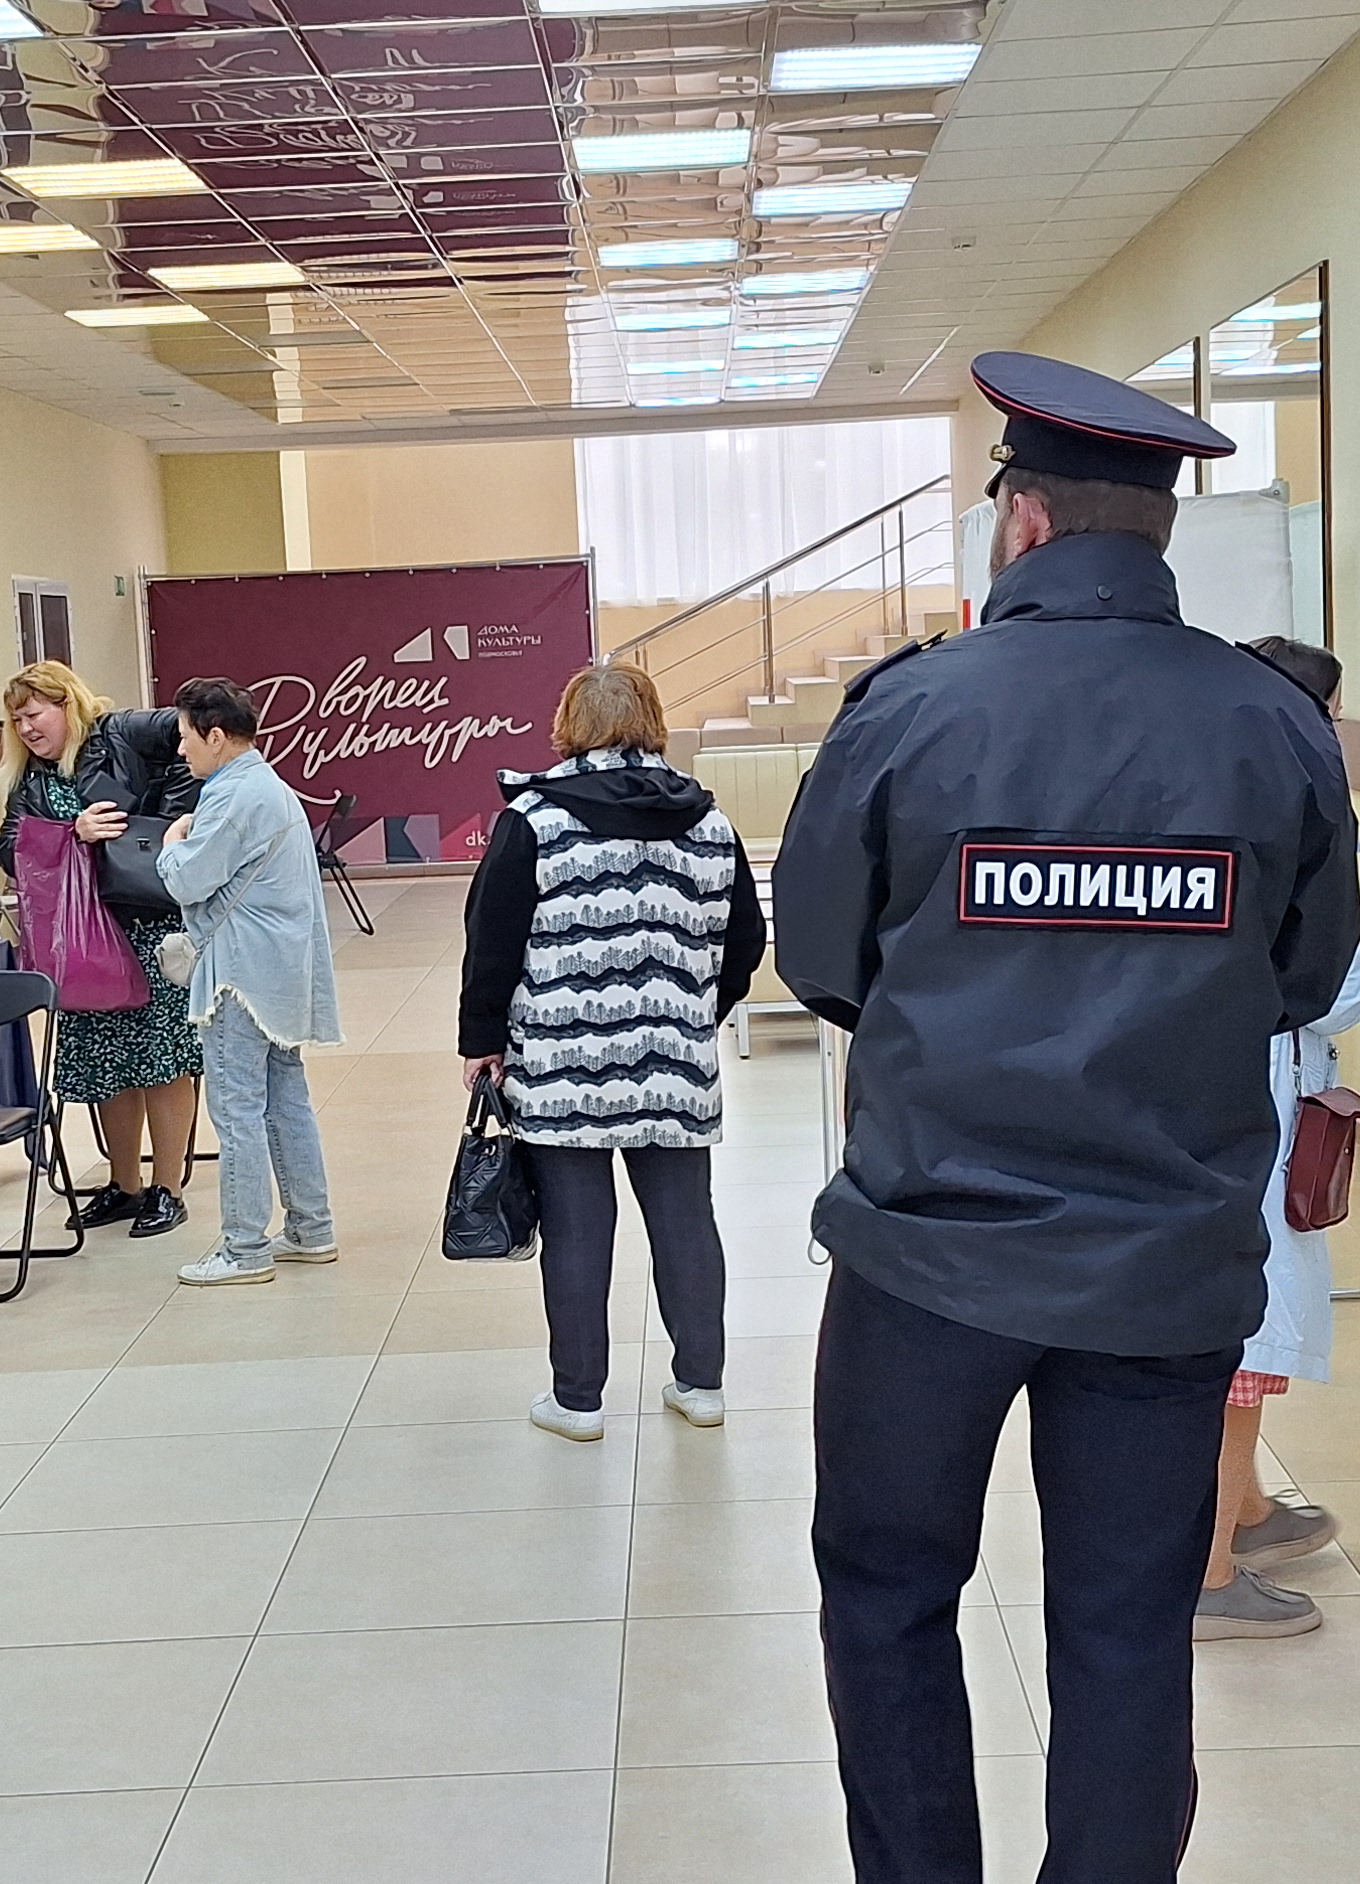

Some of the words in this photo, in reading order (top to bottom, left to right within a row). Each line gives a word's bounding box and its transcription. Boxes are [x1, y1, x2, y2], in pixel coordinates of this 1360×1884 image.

[477, 624, 519, 636] ДОМА
[477, 635, 542, 648] КУЛЬТУРЫ
[246, 655, 450, 735] Дворец
[974, 861, 1216, 916] ПОЛИЦИЯ
